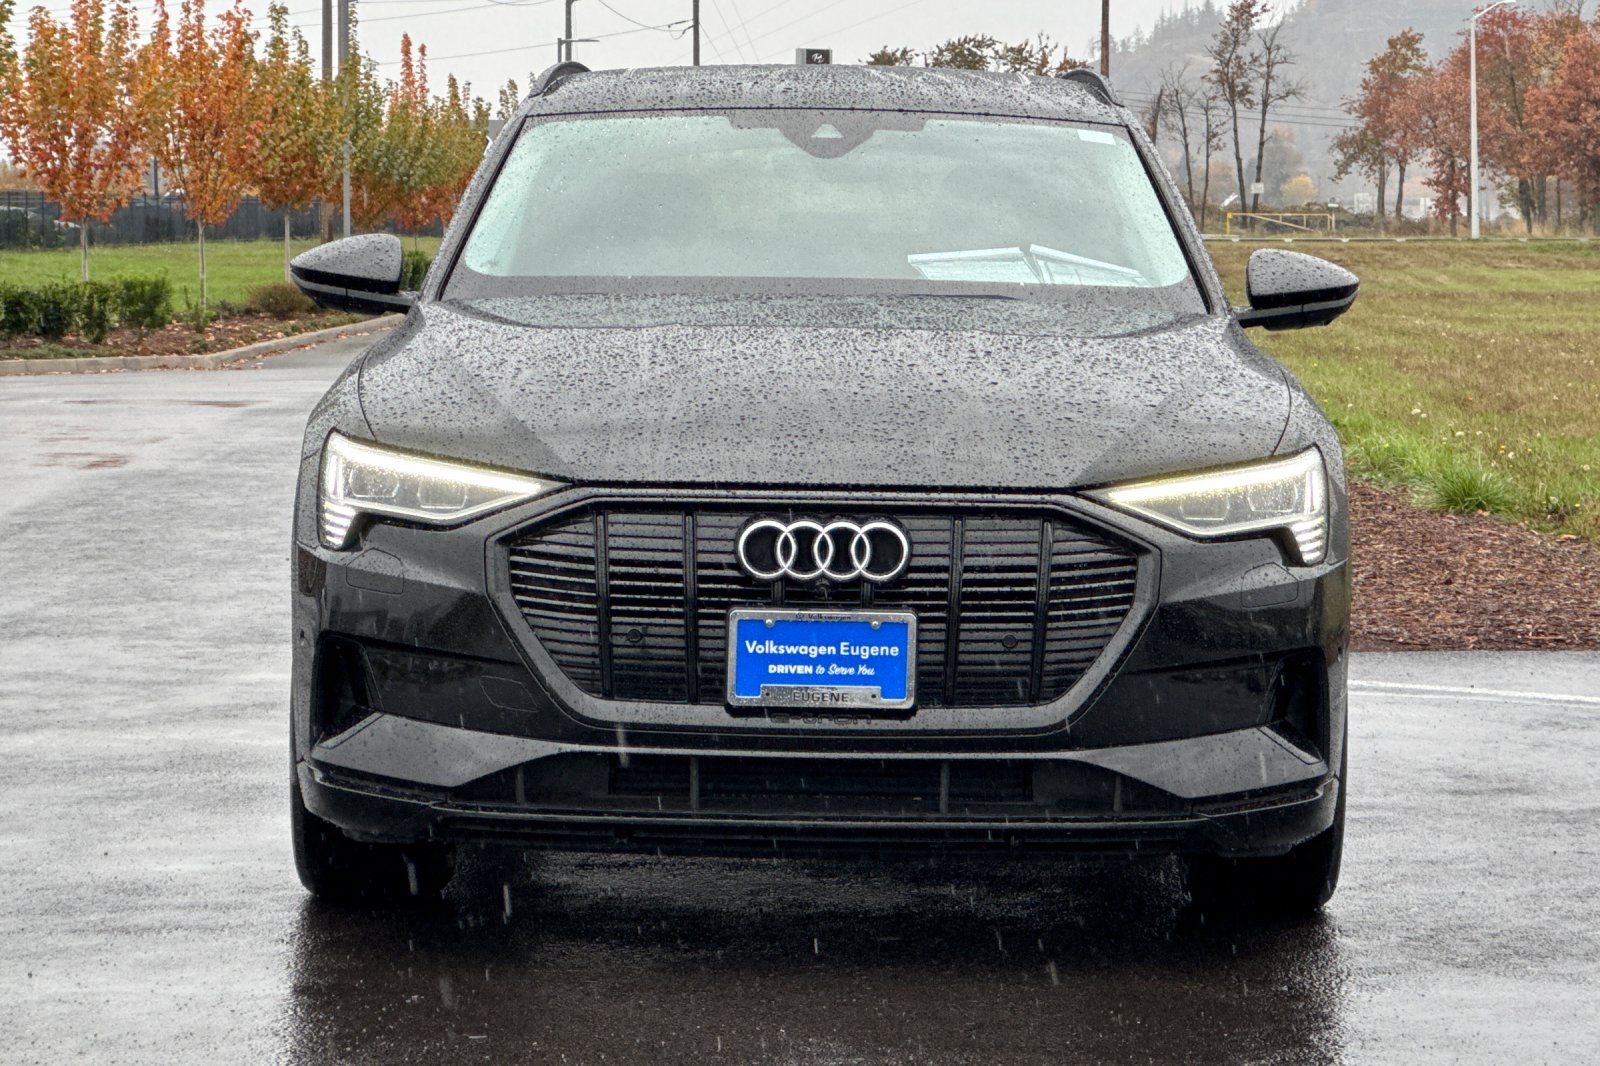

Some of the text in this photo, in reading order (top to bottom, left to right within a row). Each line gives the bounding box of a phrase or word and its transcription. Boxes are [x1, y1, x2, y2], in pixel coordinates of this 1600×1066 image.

[745, 640, 900, 660] Volkswagen Eugene
[768, 663, 876, 676] DRIVEN to Serve You
[793, 691, 849, 702] EUGENE
